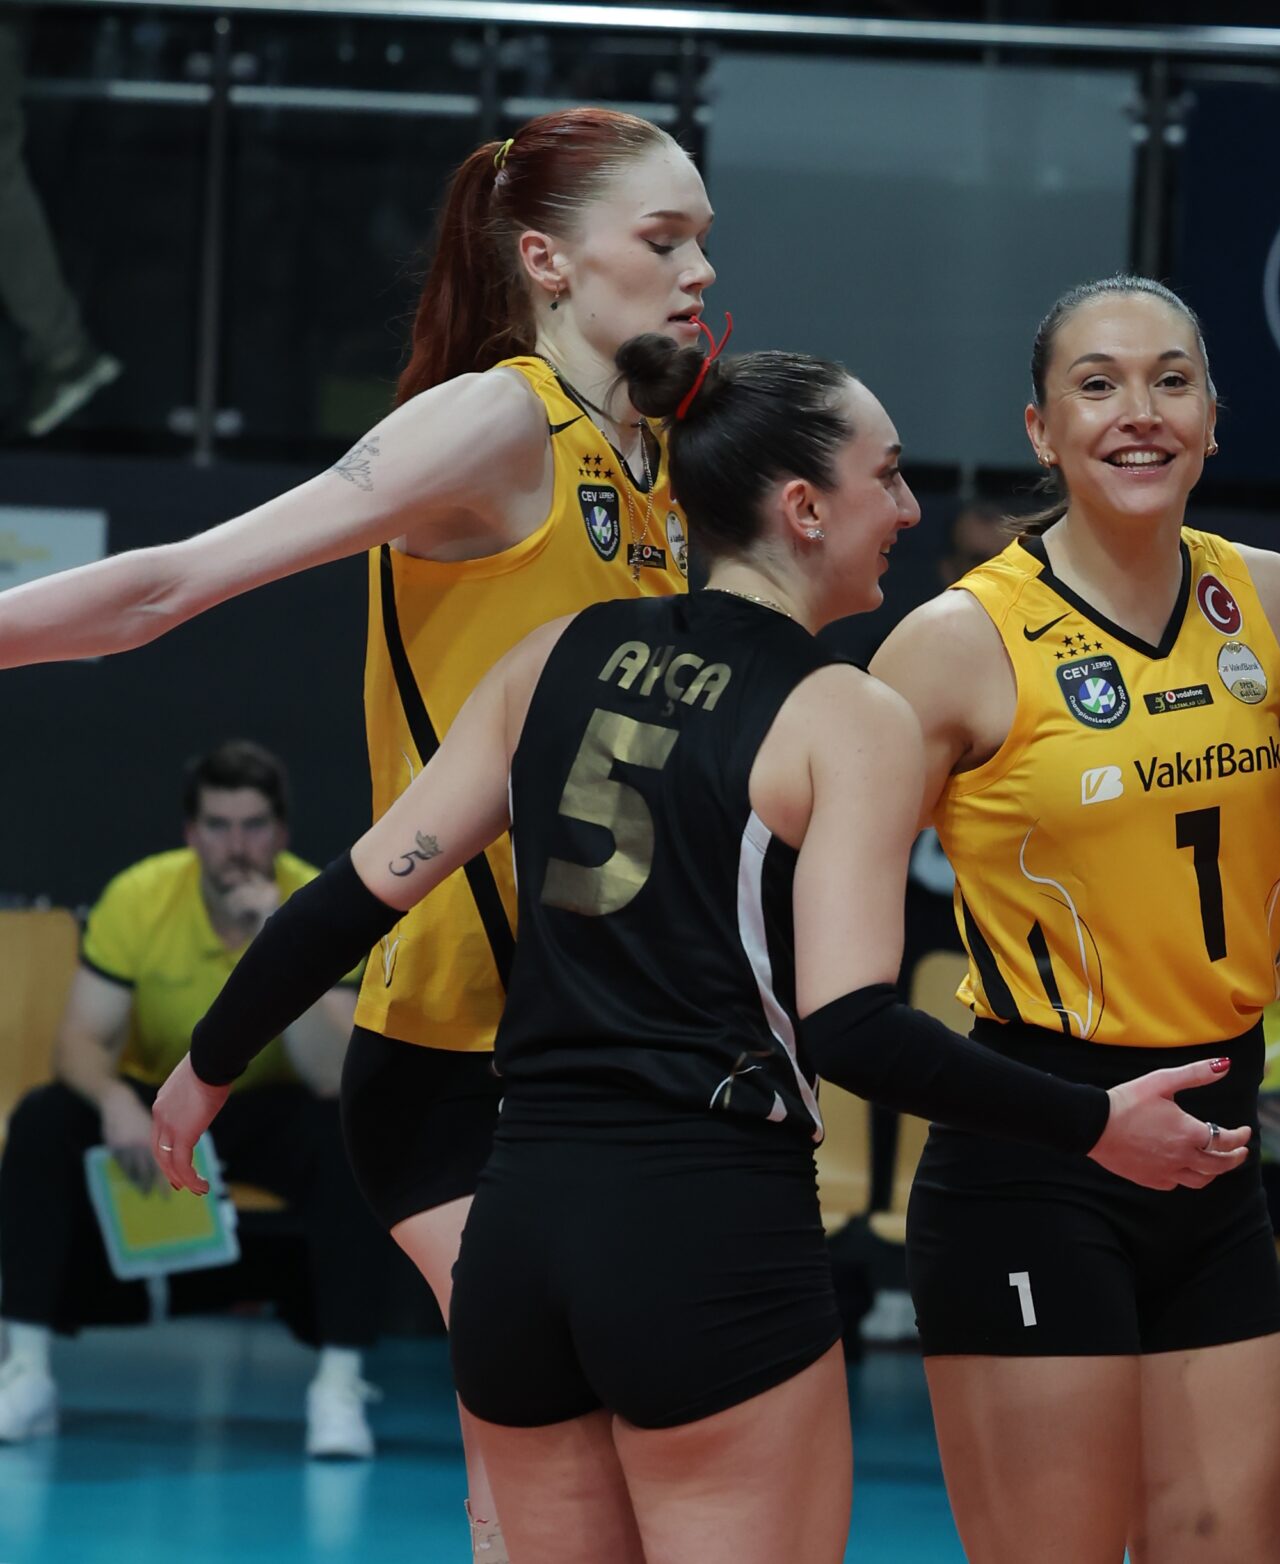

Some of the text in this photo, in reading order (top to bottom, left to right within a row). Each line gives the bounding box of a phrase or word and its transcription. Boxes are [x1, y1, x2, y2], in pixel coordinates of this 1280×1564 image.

[581, 491, 597, 502] CEV
[598, 641, 732, 716] AYÇA
[1063, 665, 1088, 680] CEV
[1176, 689, 1203, 699] vodafone
[539, 708, 680, 916] 5
[1175, 806, 1227, 962] 1
[1009, 1271, 1037, 1327] 1
